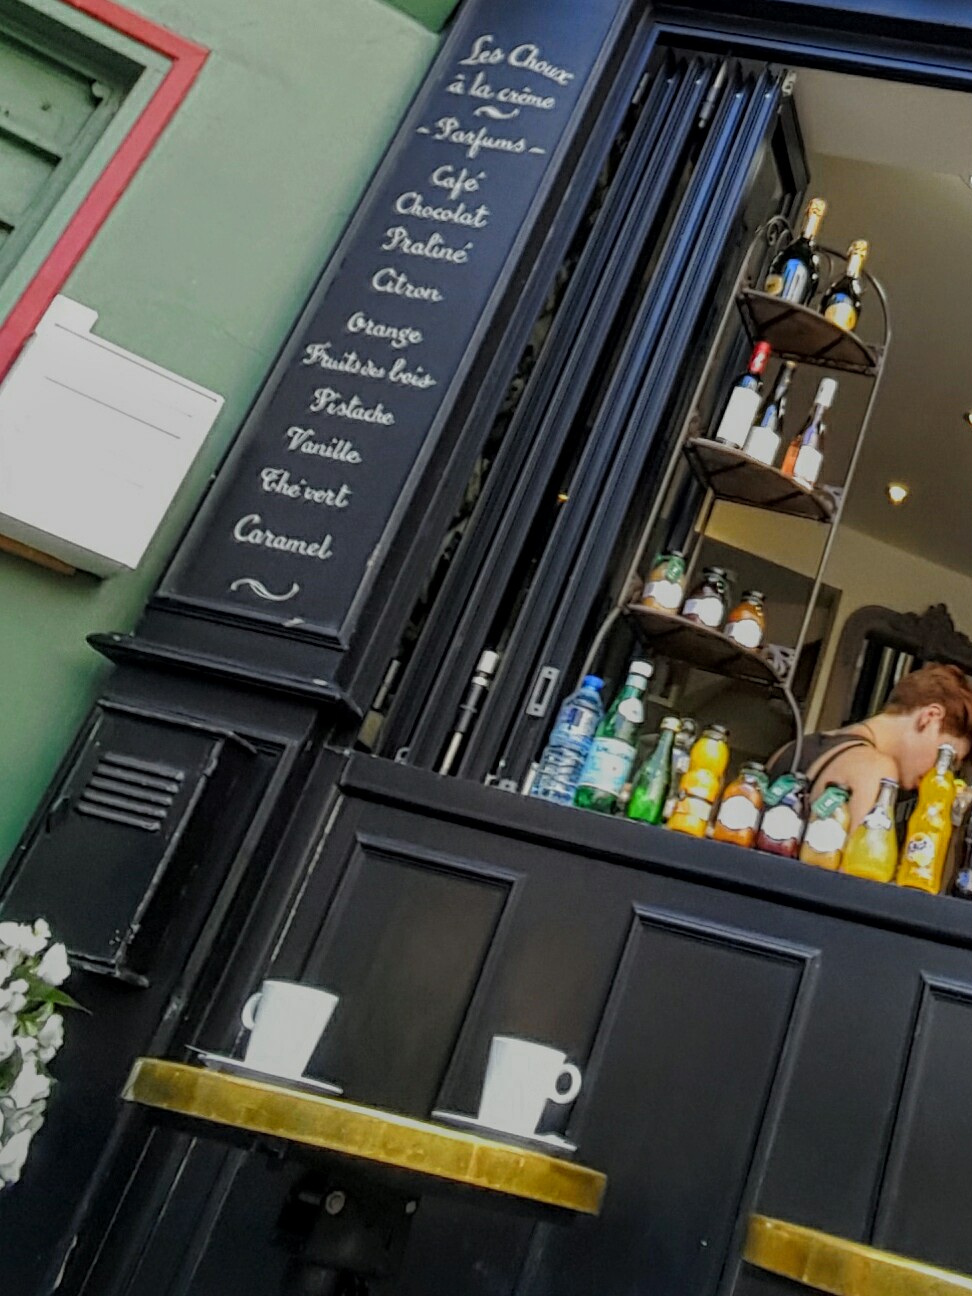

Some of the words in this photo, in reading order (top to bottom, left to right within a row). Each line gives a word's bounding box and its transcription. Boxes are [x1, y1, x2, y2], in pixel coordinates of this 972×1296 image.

[458, 34, 504, 65] Les
[507, 43, 575, 86] Choux
[468, 71, 494, 99] la
[432, 166, 486, 199] Café
[396, 192, 490, 229] Chocolat
[381, 226, 474, 265] Praliné
[372, 268, 444, 302] Citron
[346, 311, 424, 349] Orange
[309, 387, 396, 425] Pistache
[286, 426, 363, 464] Vanille
[304, 483, 353, 508] vert
[233, 514, 333, 560] Caramel
